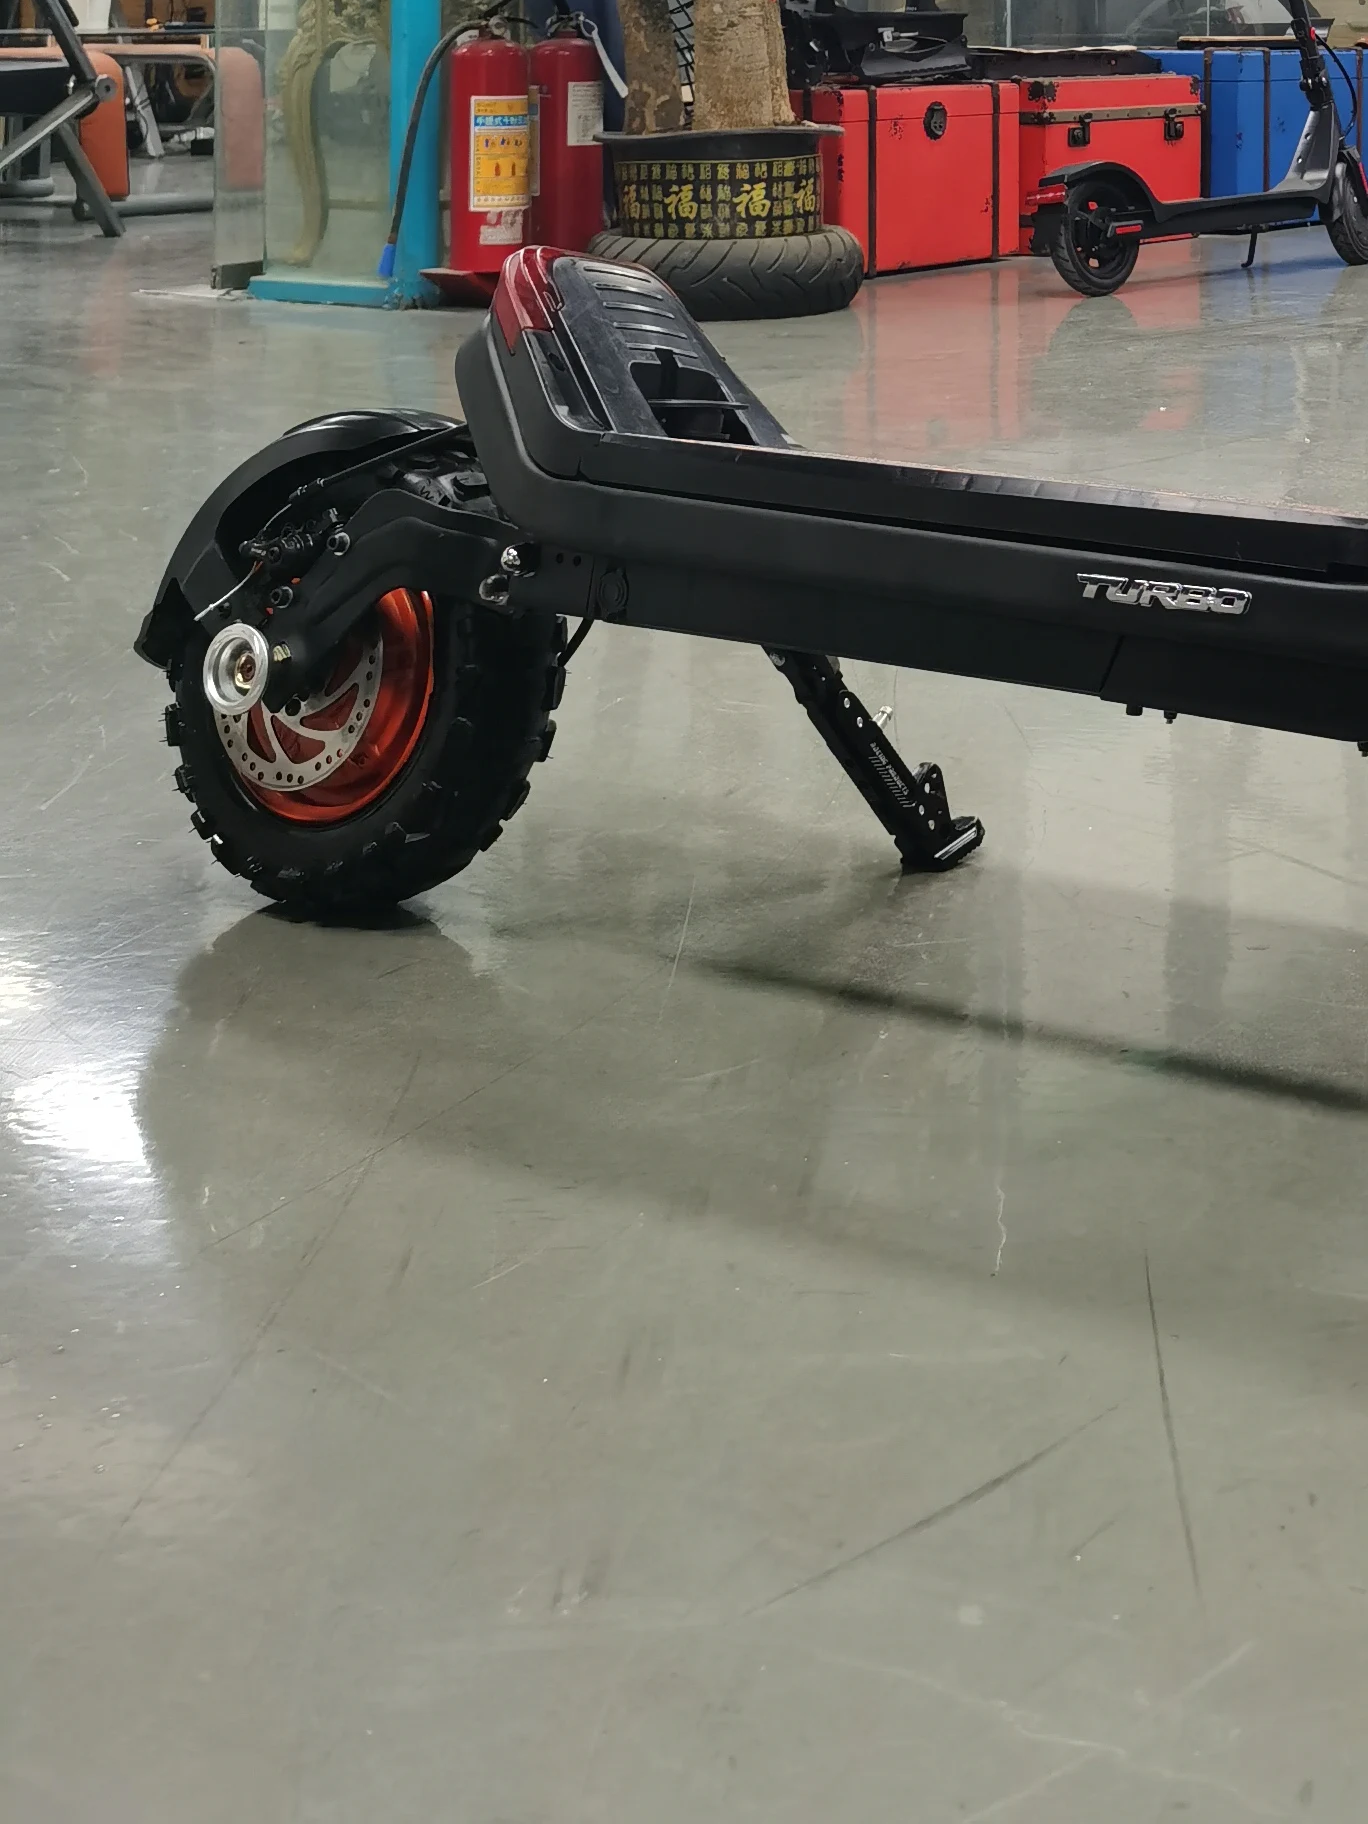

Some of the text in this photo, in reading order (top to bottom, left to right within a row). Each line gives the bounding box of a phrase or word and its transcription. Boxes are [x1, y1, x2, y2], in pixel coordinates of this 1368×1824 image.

[663, 184, 699, 220] 福
[732, 182, 771, 219] 福
[793, 177, 816, 213] 福
[1077, 573, 1252, 614] TURBO
